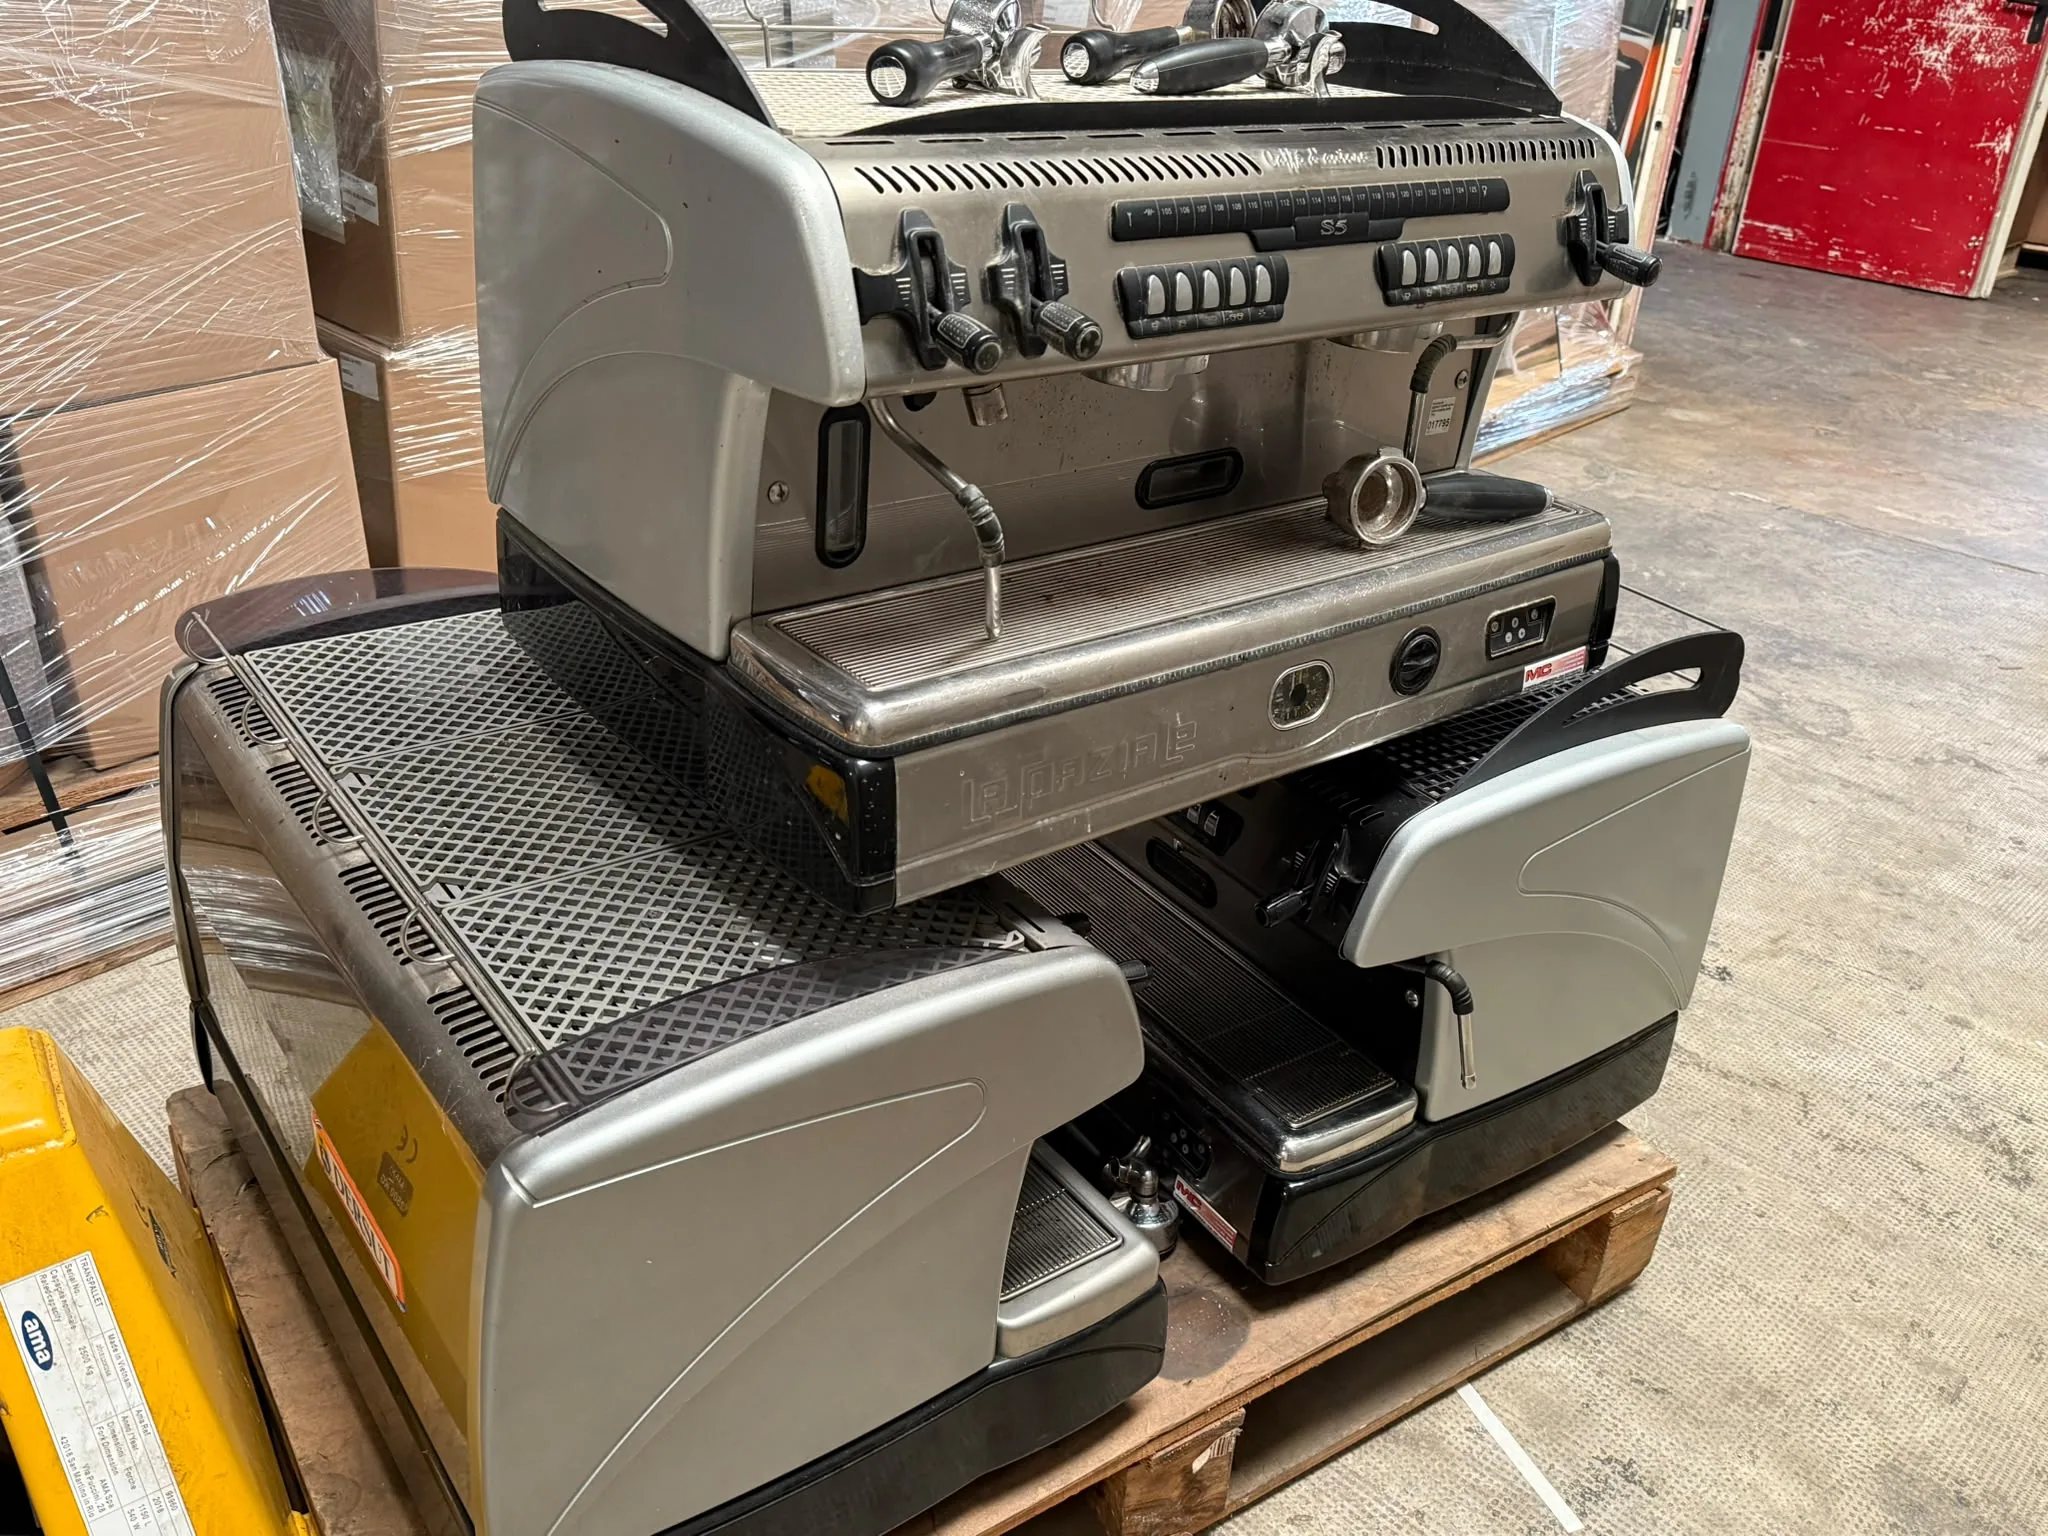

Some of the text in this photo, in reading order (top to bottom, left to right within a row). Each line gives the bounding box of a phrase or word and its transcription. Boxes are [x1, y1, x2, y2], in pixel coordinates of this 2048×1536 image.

[1320, 219, 1348, 235] S5
[1525, 663, 1552, 682] MC
[1177, 1180, 1202, 1207] MC
[333, 1165, 391, 1281] DERSUT
[64, 1263, 82, 1296] Serial No.
[79, 1257, 103, 1308] TRANSPALLET
[39, 1273, 63, 1324] Rated capacity
[61, 1299, 77, 1330] nominale
[23, 1317, 51, 1364] ama
[78, 1345, 95, 1376] 2500 Kg
[107, 1333, 133, 1388] Made in Vietnam
[121, 1415, 133, 1433] Anno
[135, 1408, 146, 1424] Ama
[96, 1425, 120, 1476] Fork Dimension
[106, 1421, 138, 1491] Dimensioni Forche
[59, 1435, 73, 1458] 42018
[67, 1457, 78, 1472] San
[73, 1472, 88, 1498] Martino
[86, 1505, 96, 1518] Rio
[82, 1463, 106, 1513] Via Puccini, 28
[99, 1478, 116, 1509] AMA Spa
[153, 1496, 164, 1514] 2018
[127, 1508, 140, 1531] 540 W
[138, 1504, 149, 1520] 1150
